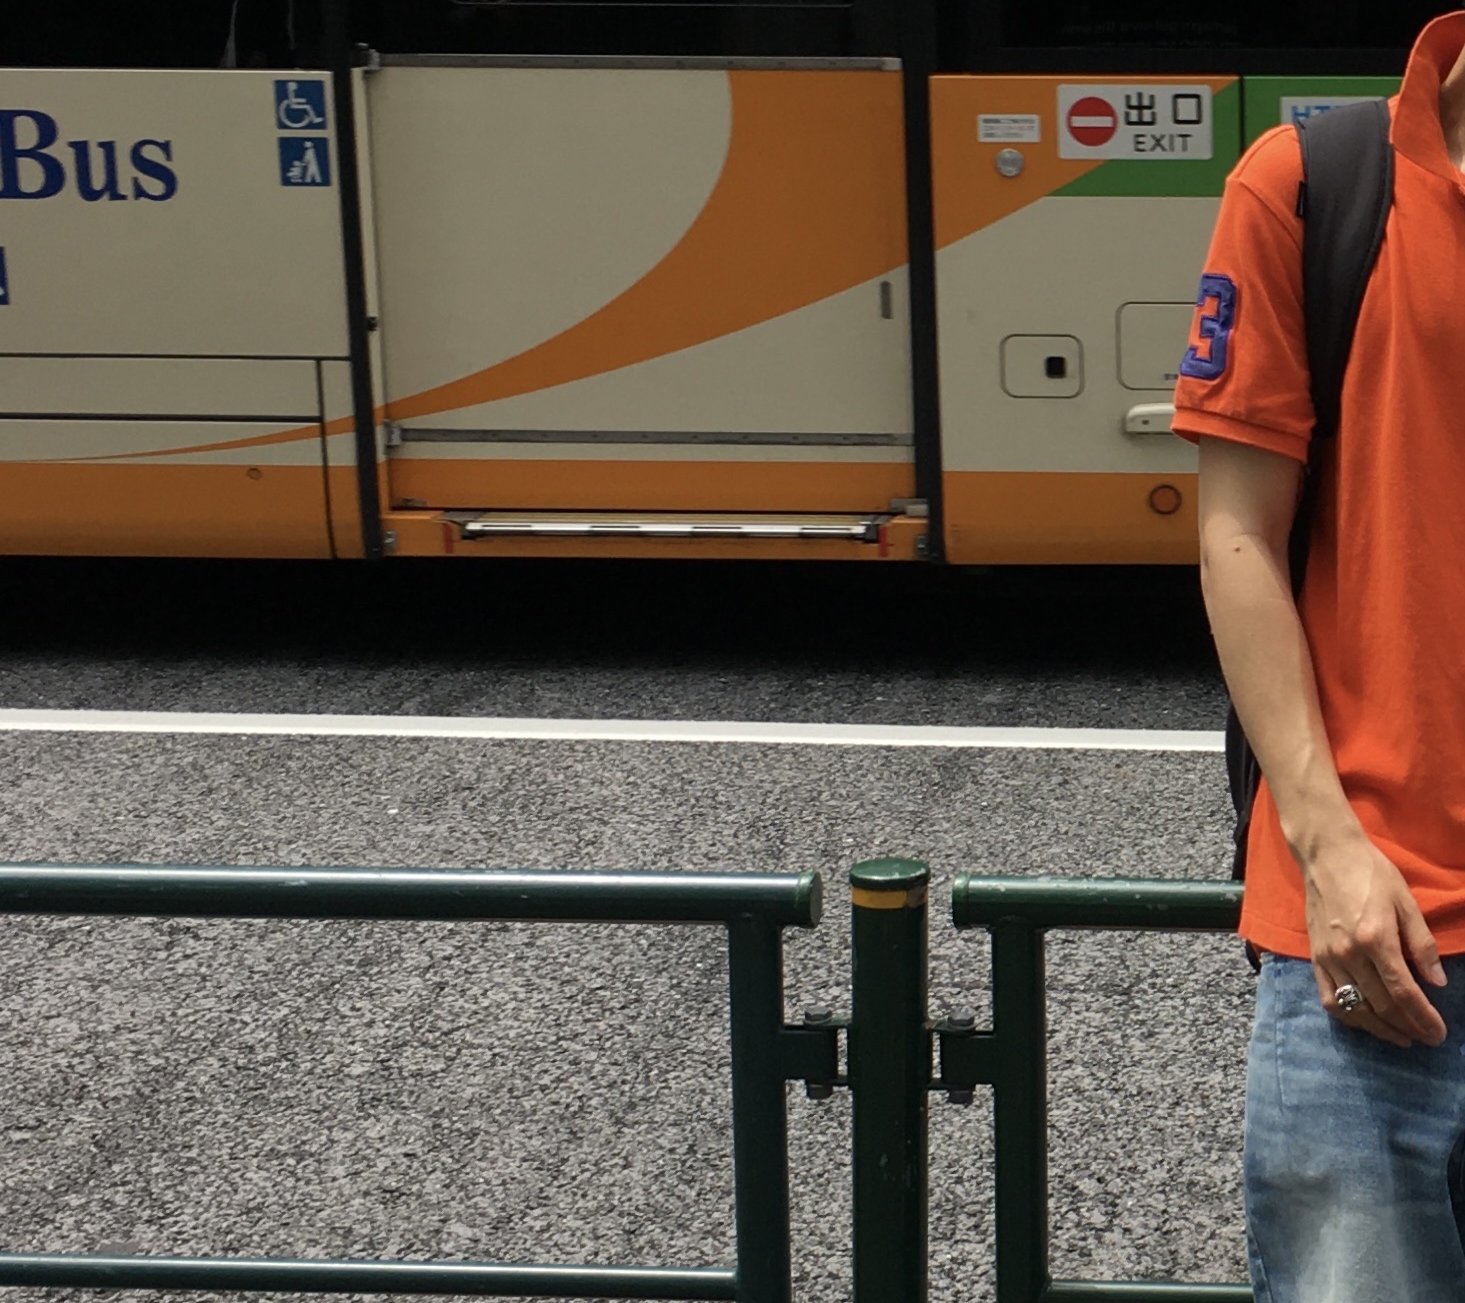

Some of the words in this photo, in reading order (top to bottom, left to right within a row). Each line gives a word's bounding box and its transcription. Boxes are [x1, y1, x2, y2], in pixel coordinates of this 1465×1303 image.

[1123, 91, 1203, 127] 出口
[0, 109, 178, 202] Bus
[1132, 133, 1193, 154] EXIT
[1179, 273, 1238, 382] 3
